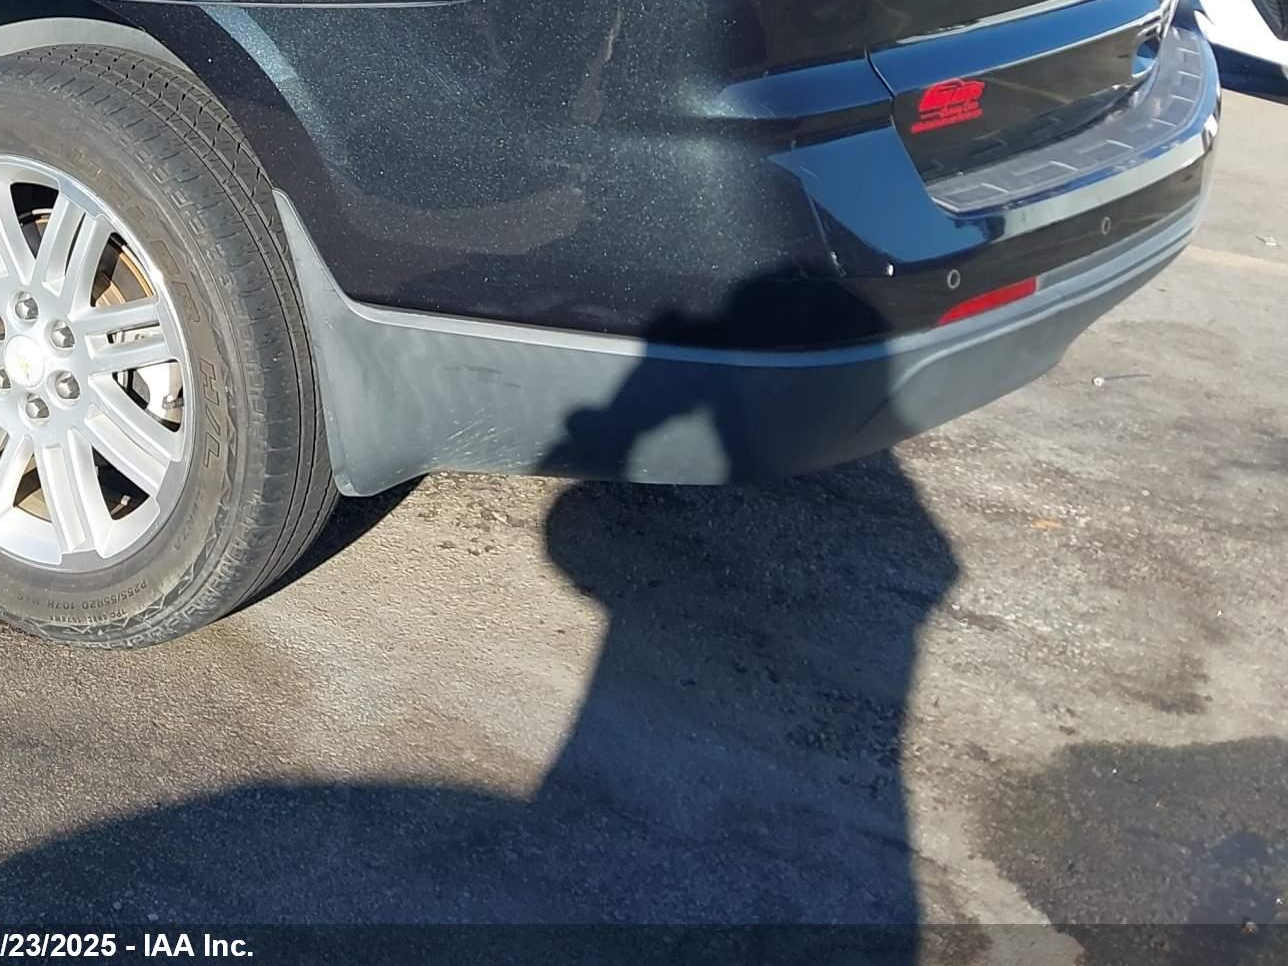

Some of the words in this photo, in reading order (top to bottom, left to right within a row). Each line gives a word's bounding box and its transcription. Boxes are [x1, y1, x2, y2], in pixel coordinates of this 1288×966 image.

[199, 356, 222, 468] H/L
[47, 600, 75, 611] 107H
[81, 579, 148, 611] P255/55R20
